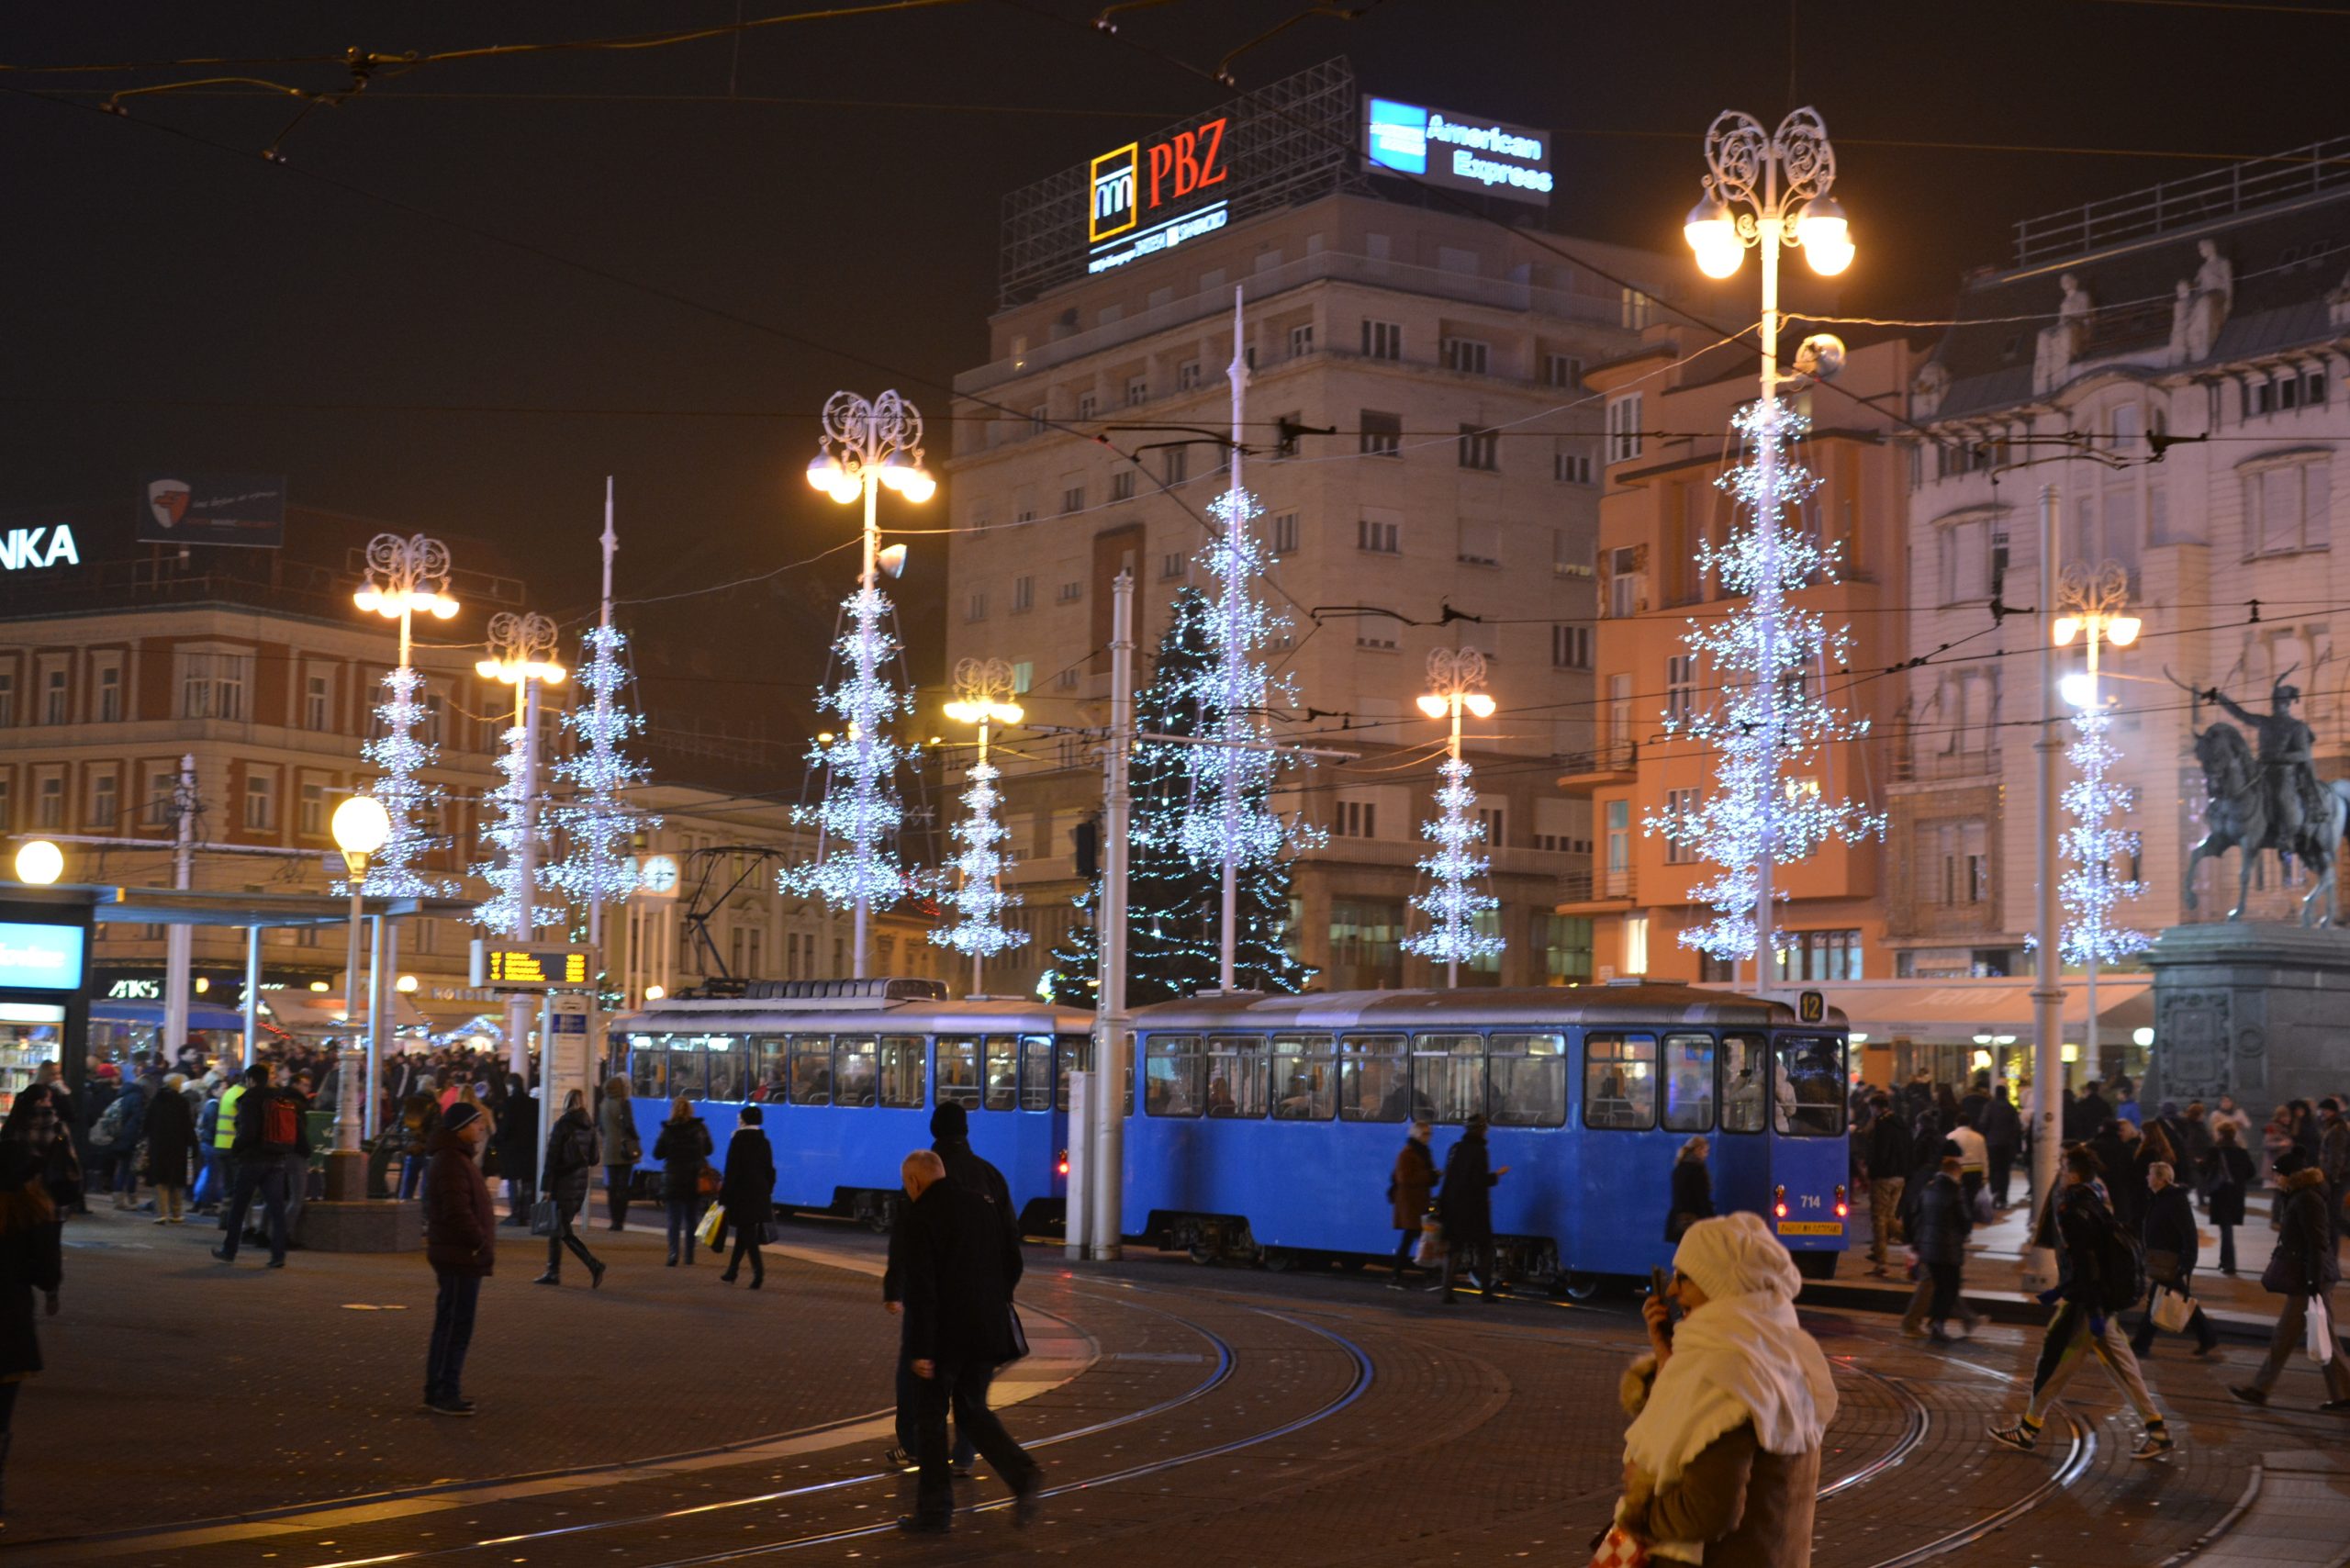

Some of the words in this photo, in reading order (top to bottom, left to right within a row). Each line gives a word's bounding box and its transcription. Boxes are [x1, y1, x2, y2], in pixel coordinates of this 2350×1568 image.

[1426, 114, 1542, 160] American
[1147, 118, 1228, 208] PBZ
[1452, 149, 1553, 192] Express
[1804, 996, 1820, 1019] 12
[1800, 1194, 1821, 1209] 714
